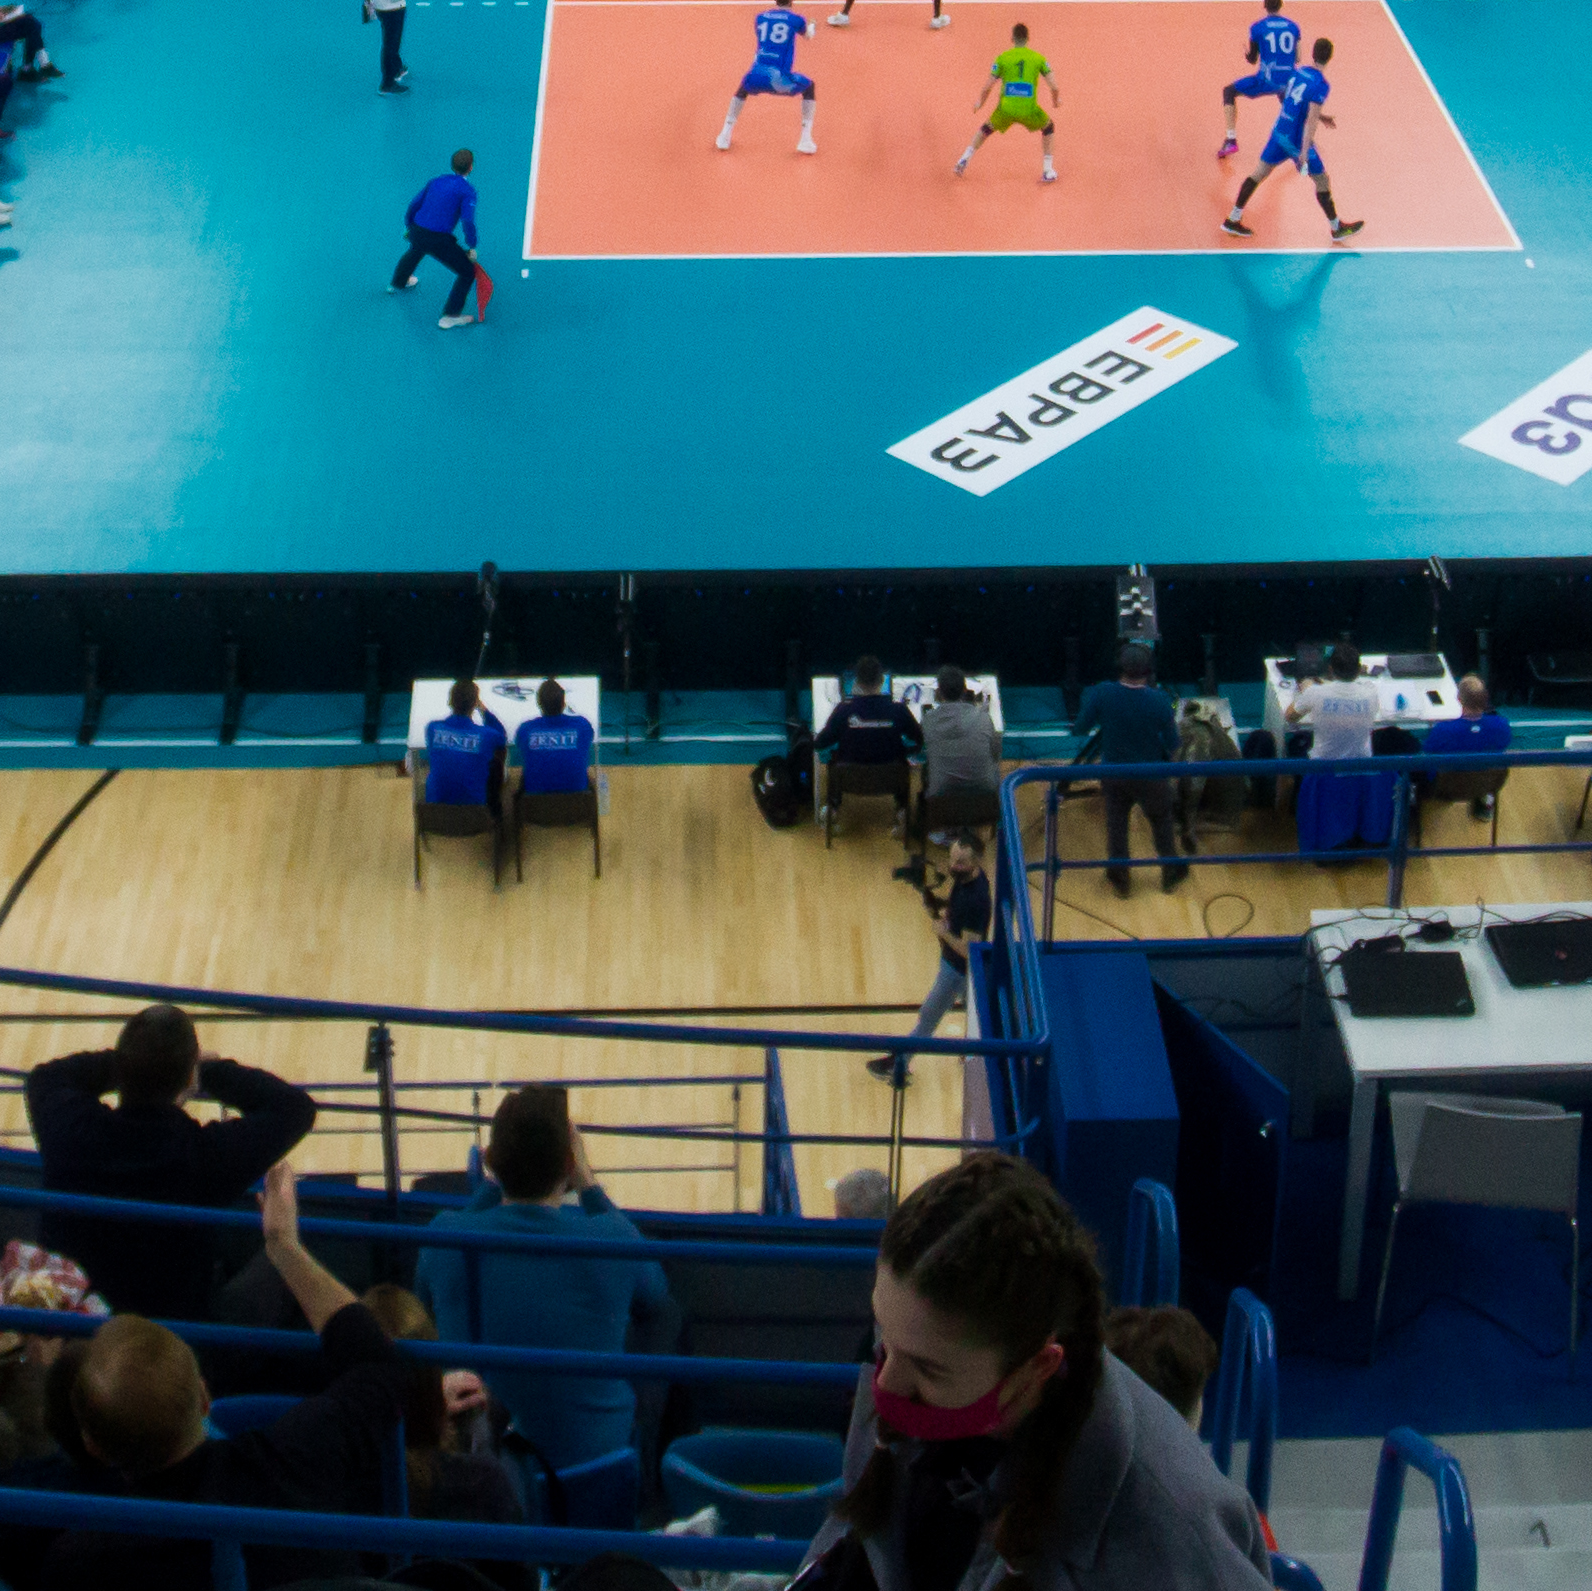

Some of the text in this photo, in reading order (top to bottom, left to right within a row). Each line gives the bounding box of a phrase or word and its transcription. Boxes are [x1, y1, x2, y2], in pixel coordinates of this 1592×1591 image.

[757, 21, 790, 44] 18
[1265, 31, 1294, 54] 10
[1015, 58, 1025, 78] 1
[1284, 76, 1307, 105] 14
